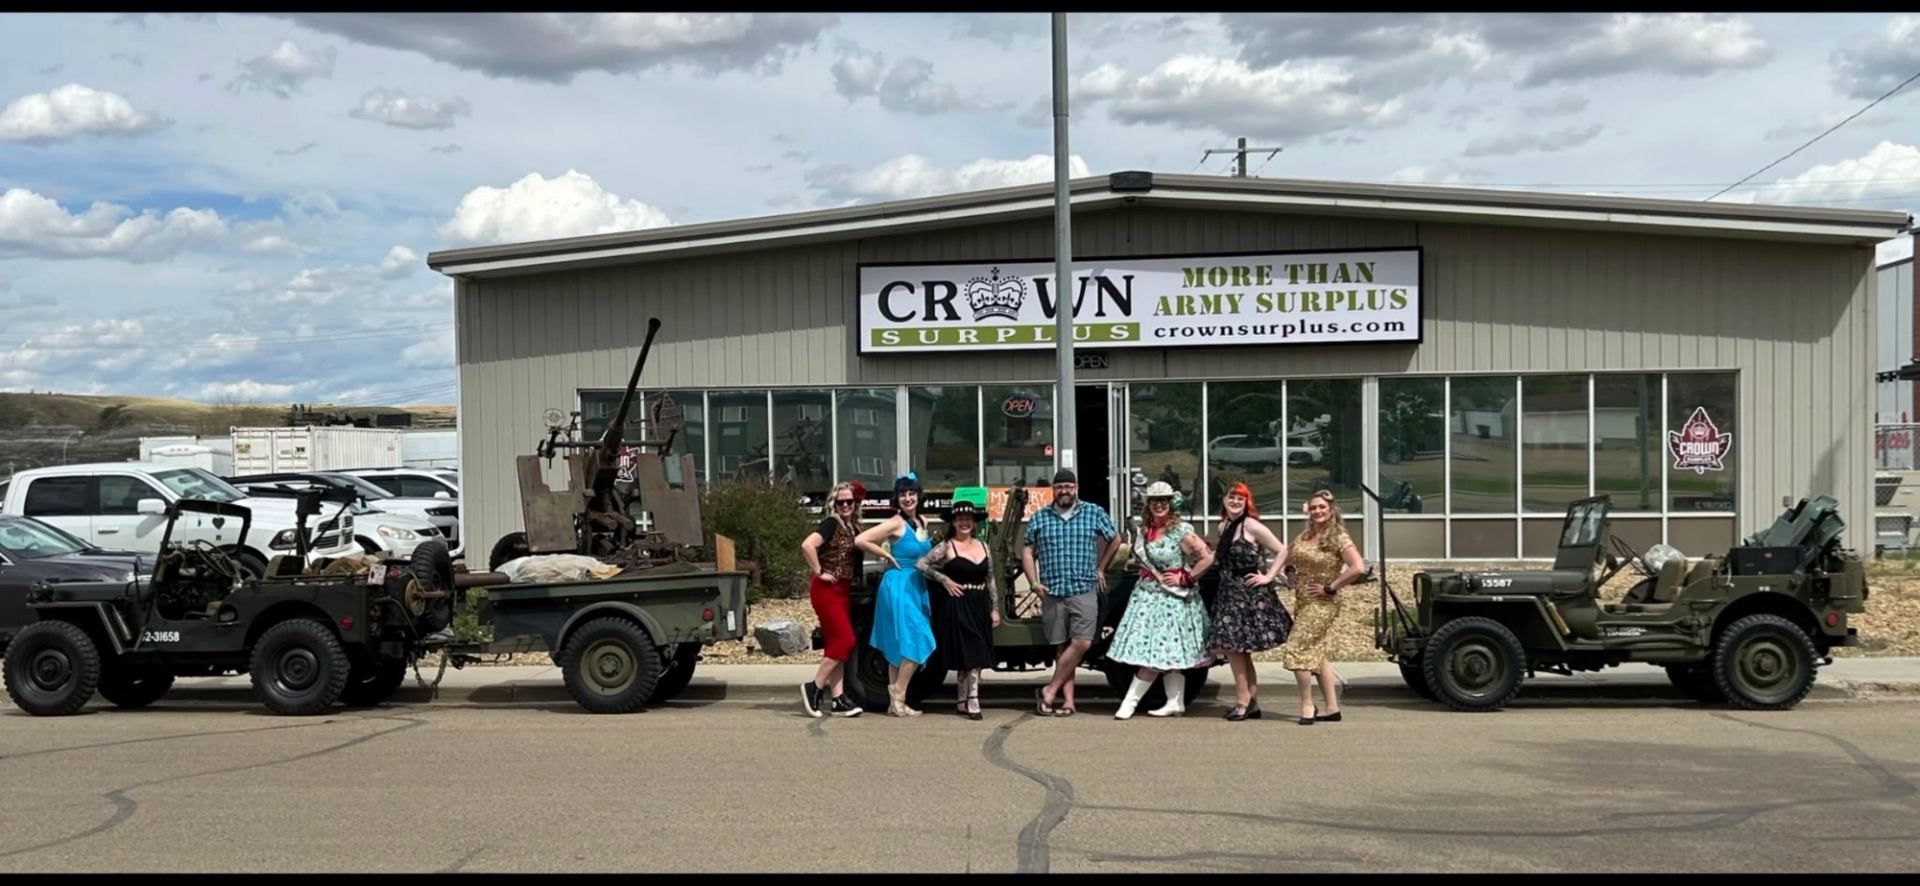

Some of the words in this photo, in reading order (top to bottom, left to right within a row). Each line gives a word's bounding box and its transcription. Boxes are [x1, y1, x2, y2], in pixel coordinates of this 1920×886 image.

[1181, 264, 1273, 288] MORE
[1284, 261, 1376, 285] THAN
[878, 275, 1134, 322] CRWN
[1153, 293, 1245, 316] ARMY
[1255, 288, 1408, 313] SURPLUS
[881, 325, 1130, 345] SURPLUS
[1154, 319, 1406, 338] crownsurplus.com
[1074, 354, 1108, 369] OPEN
[1006, 399, 1035, 412] OPEN
[1679, 442, 1720, 455] CROWN
[991, 491, 1046, 503] MYRY
[143, 631, 180, 642] 2-31658
